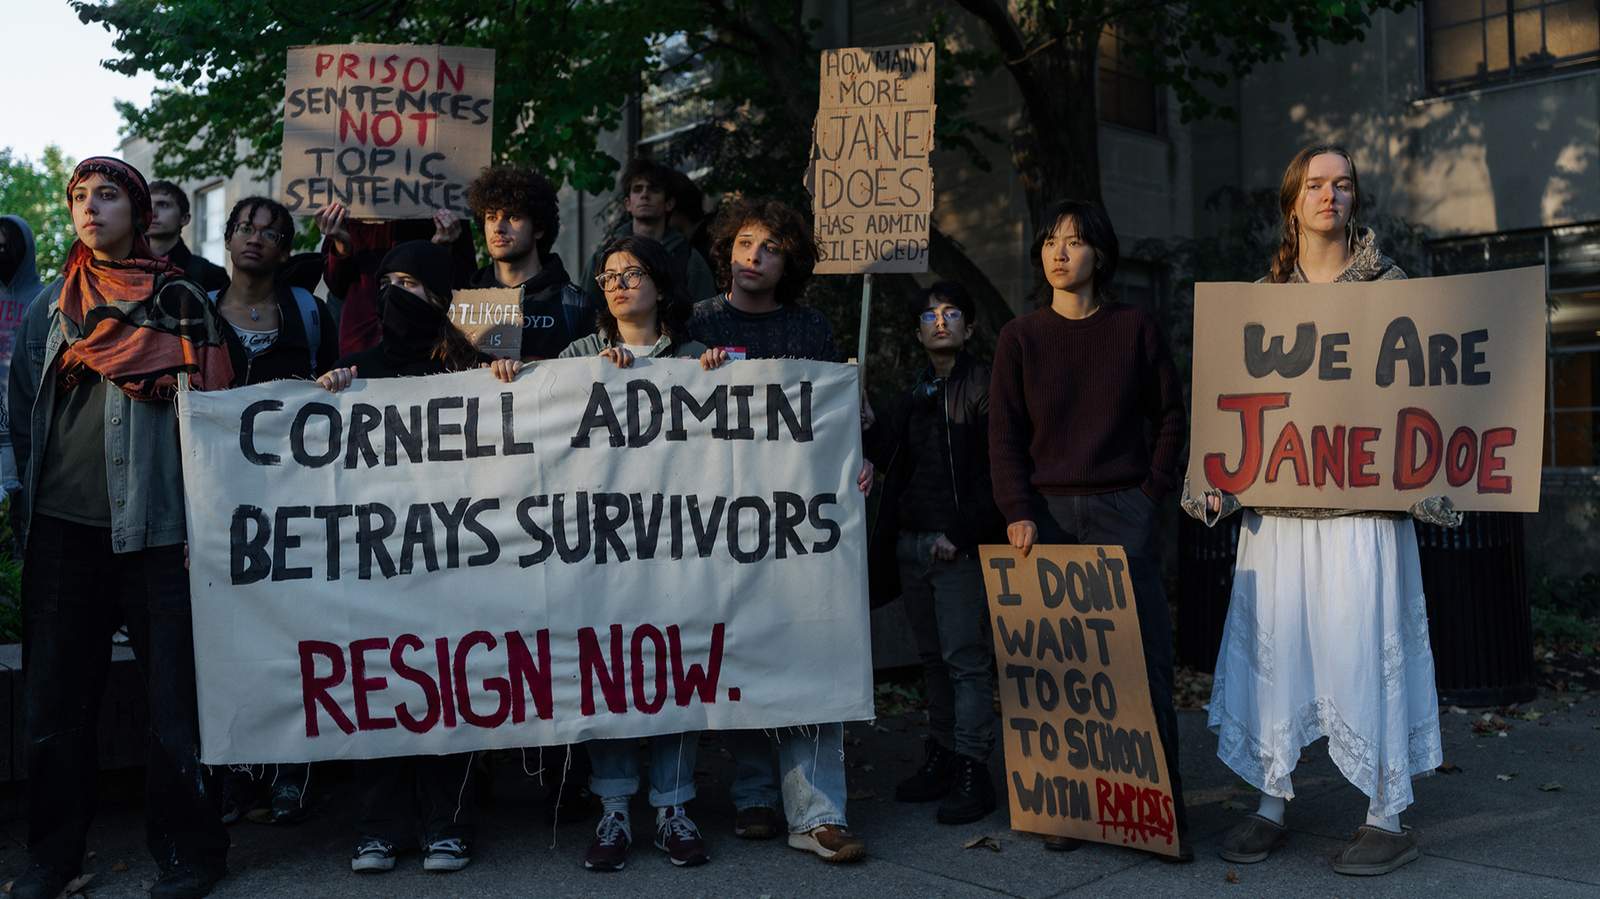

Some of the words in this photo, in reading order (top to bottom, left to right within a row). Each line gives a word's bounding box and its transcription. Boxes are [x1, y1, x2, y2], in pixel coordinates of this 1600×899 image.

[316, 53, 464, 92] PRISON
[827, 51, 870, 76] HOW
[876, 46, 933, 74] MANY
[287, 85, 492, 125] SENTENCES
[840, 77, 907, 105] MORE
[339, 108, 439, 148] NOT
[823, 109, 929, 161] JANE
[305, 147, 448, 180] TOPIC
[821, 168, 923, 209] DOES
[819, 215, 855, 236] HAS
[866, 214, 926, 235] ADMIN
[818, 238, 929, 264] SILENCED?
[490, 334, 502, 346] IS
[523, 315, 554, 328] OYD
[239, 392, 535, 470] CORNELL
[570, 379, 814, 448] ADMIN
[1203, 392, 1381, 495] JANE
[1393, 407, 1517, 494] DOE
[229, 497, 501, 586] BETRAYS
[516, 491, 842, 569] SURVIVORS
[990, 558, 1022, 606] I
[1036, 547, 1127, 614] DON'T
[997, 615, 1115, 667] WANT
[298, 629, 553, 737] RESIGN
[577, 623, 741, 716] NOW.
[1005, 663, 1059, 712] TO
[1063, 668, 1118, 721] GO
[1010, 717, 1060, 762] TO
[1063, 718, 1160, 784] SCHOOL
[1012, 771, 1092, 821] WITH
[1095, 776, 1175, 835] RAPISTS
